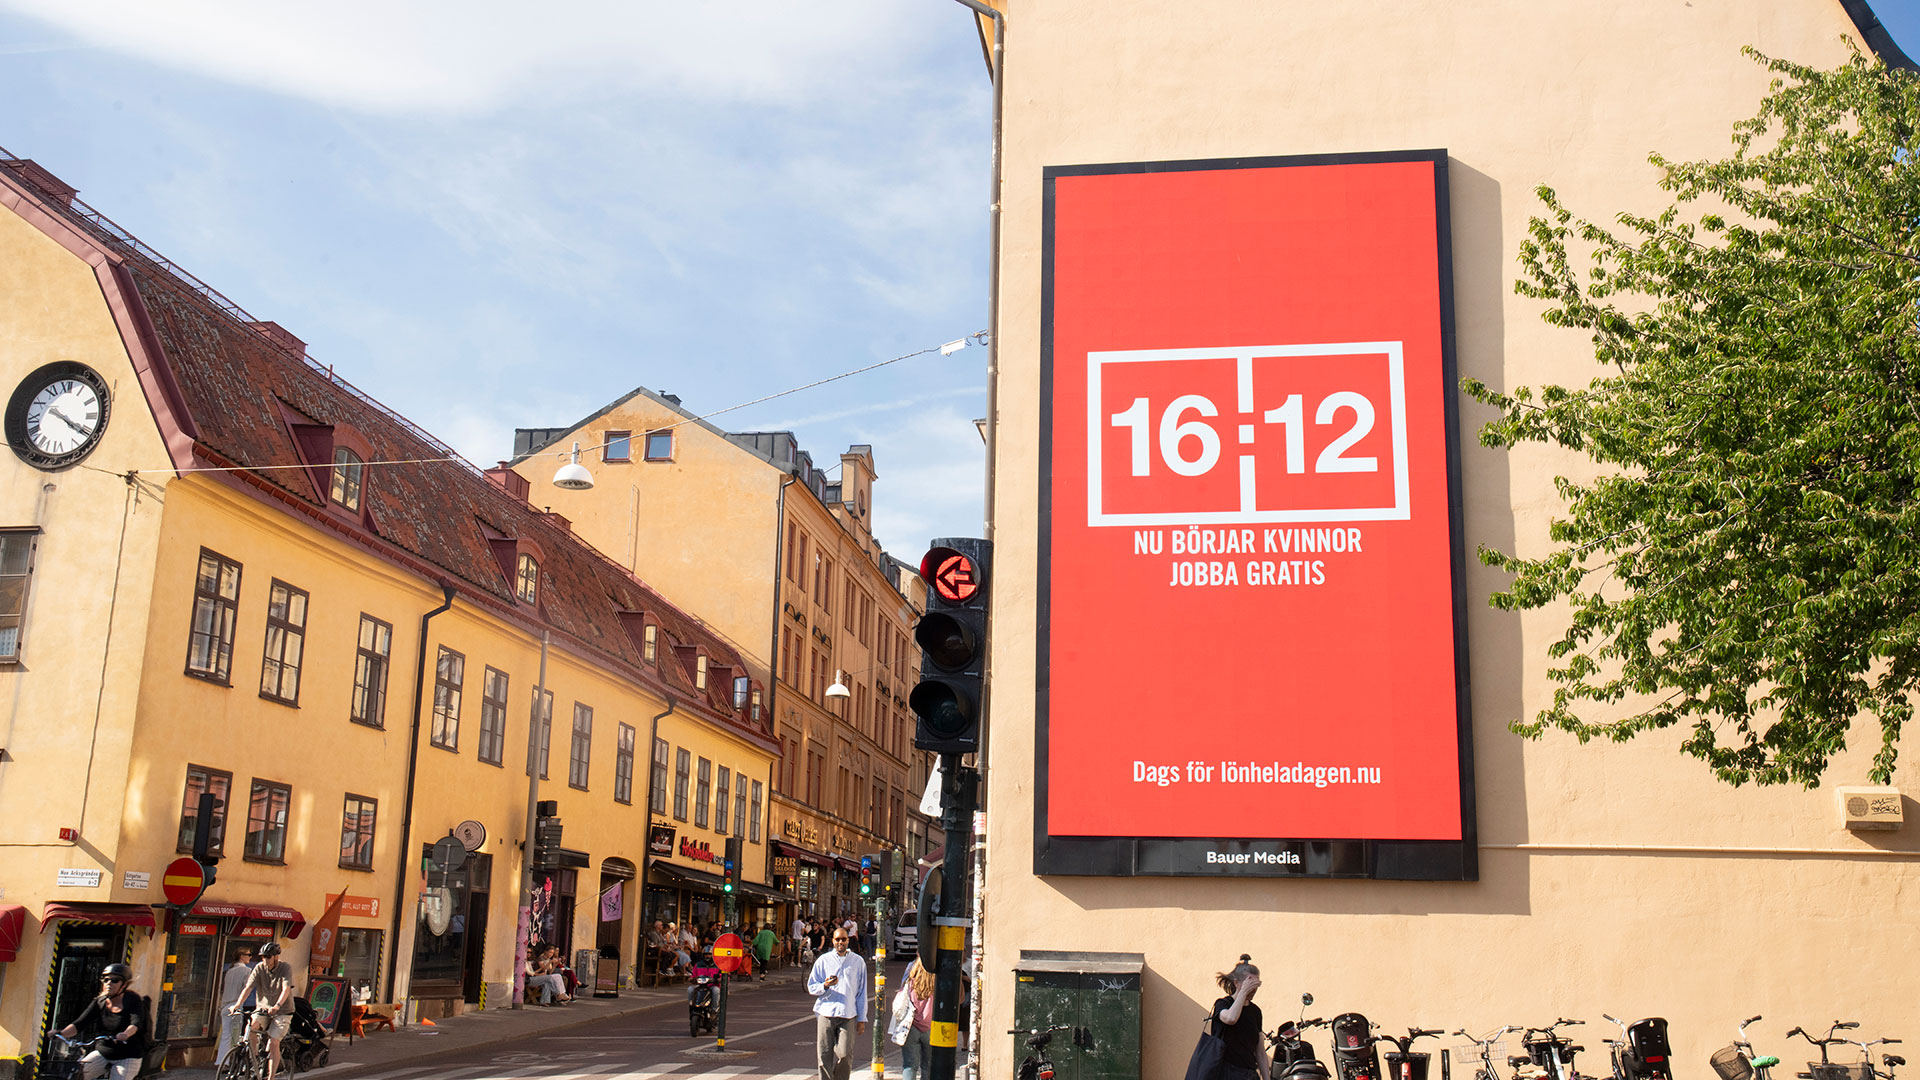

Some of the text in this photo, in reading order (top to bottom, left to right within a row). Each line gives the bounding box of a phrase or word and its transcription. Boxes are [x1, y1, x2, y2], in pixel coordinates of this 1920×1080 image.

[1134, 525, 1362, 554] NU BÖRJAR KVINNOR
[1170, 560, 1325, 586] JOBBA GRATIS
[1133, 761, 1381, 788] Dags för lönheladagen.nu
[775, 857, 797, 866] BAR
[1206, 851, 1300, 865] Bauer Media
[183, 925, 207, 933] TOBAK
[253, 928, 272, 936] GODIS
